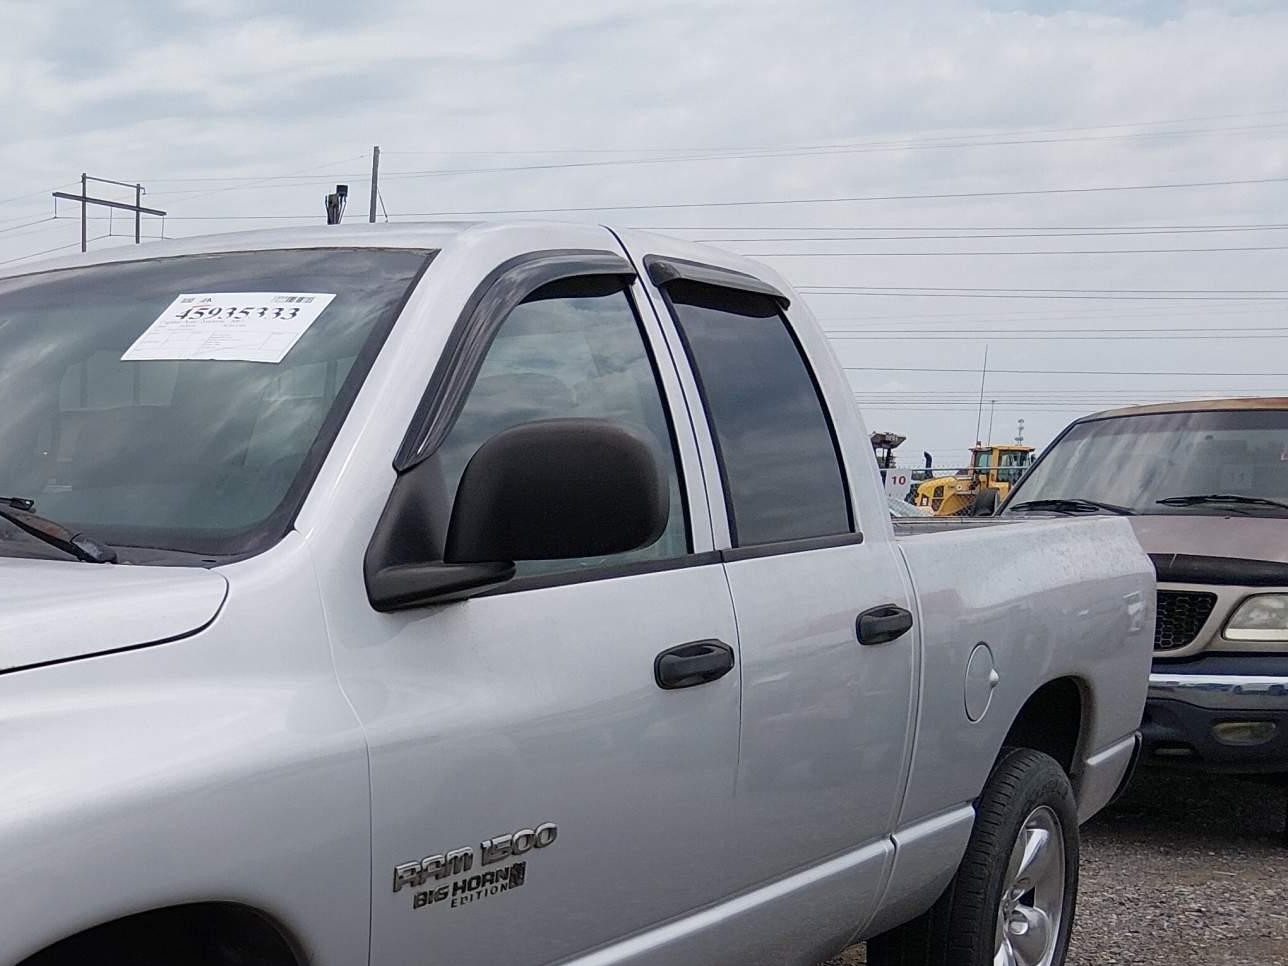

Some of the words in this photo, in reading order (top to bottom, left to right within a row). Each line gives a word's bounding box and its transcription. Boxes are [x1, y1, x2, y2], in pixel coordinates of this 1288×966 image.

[175, 307, 300, 320] 45935333
[892, 476, 906, 485] 10
[393, 846, 474, 893] RAM
[480, 821, 558, 867] 1500
[413, 885, 450, 910] BIG
[452, 866, 511, 897] HORN
[450, 882, 510, 909] EDITION
